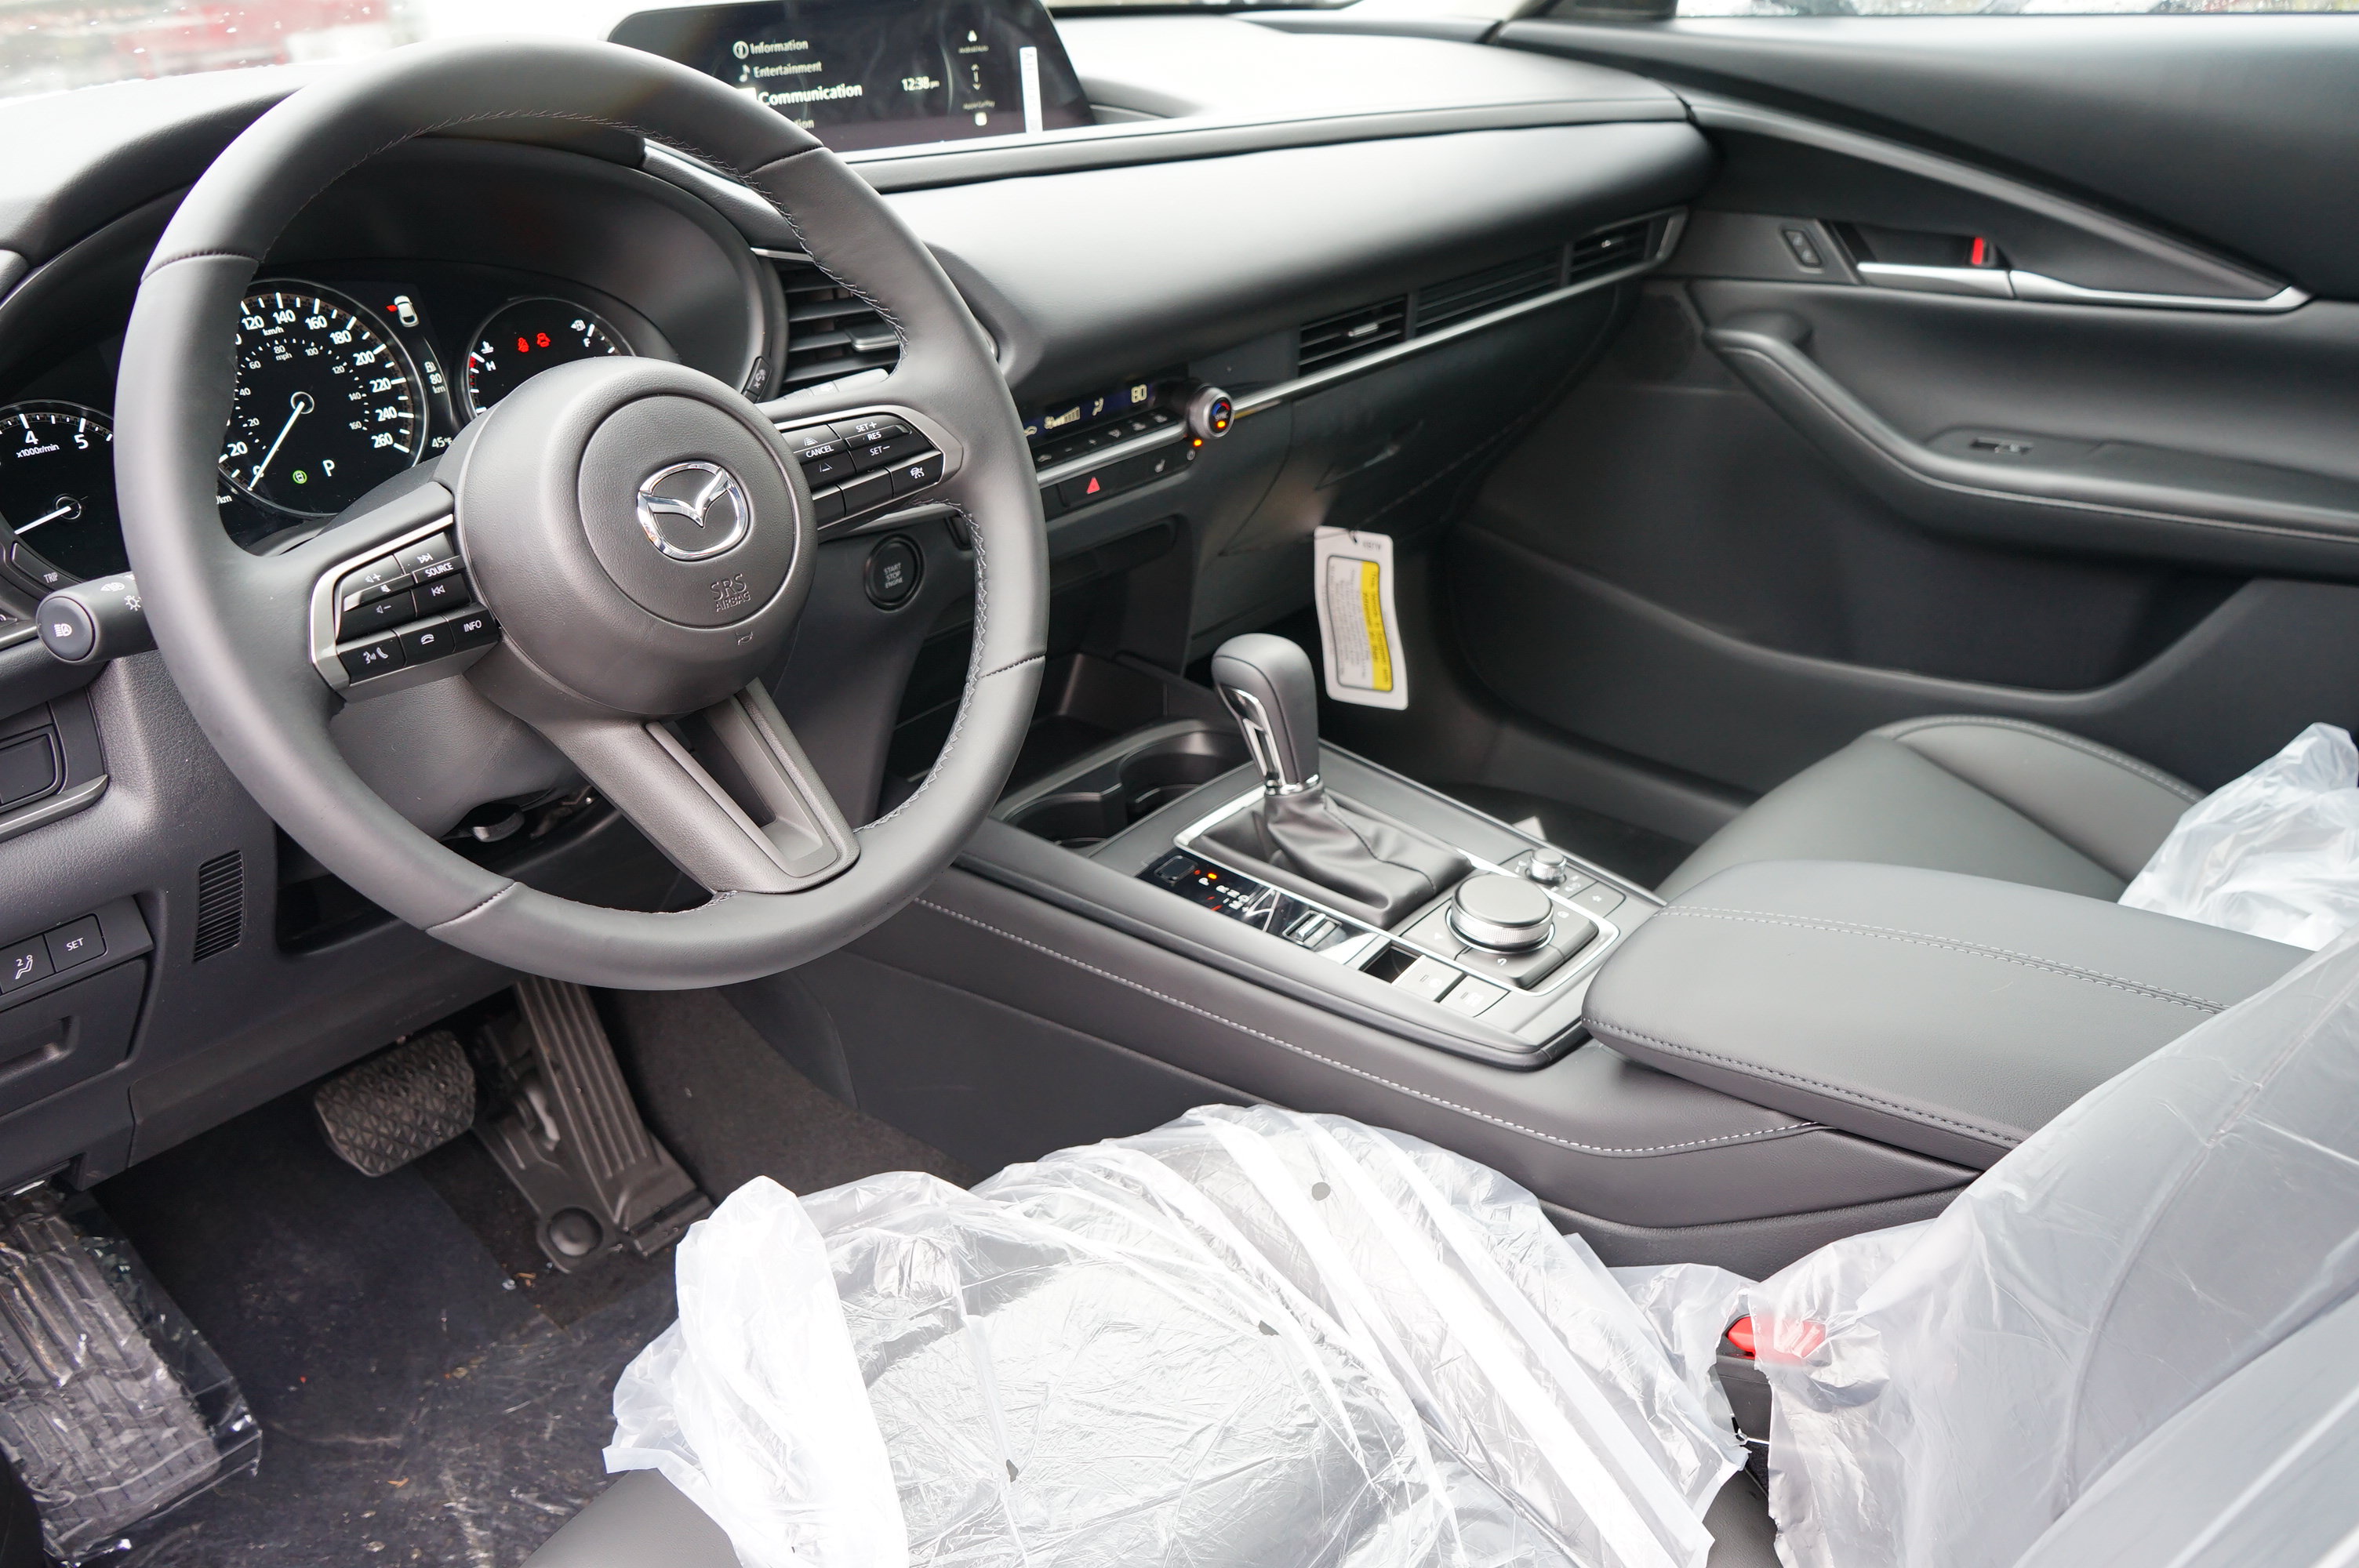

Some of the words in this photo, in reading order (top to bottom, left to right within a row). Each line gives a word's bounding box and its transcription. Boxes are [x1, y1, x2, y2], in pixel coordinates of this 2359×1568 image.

[750, 39, 809, 54] Information
[753, 61, 823, 78] Entertainment
[758, 83, 863, 106] Communication
[242, 314, 264, 330] 120
[273, 309, 296, 325] 140
[305, 314, 328, 330] 160
[262, 326, 285, 336] km/h
[329, 329, 352, 345] 180
[273, 345, 286, 354] 80
[275, 352, 293, 361] mph
[305, 347, 319, 357] 100
[249, 360, 261, 370] 60
[353, 350, 375, 366] 200
[332, 365, 345, 374] 120
[485, 361, 496, 371] H
[239, 387, 251, 396] 40
[369, 377, 391, 393] 220
[348, 392, 362, 401] 140
[375, 406, 398, 422] 240
[248, 418, 260, 427] 20
[349, 421, 362, 430] 160
[25, 430, 39, 445] 4
[74, 434, 89, 449] 5
[371, 433, 394, 448] 260
[867, 431, 881, 441] RES
[227, 441, 248, 457] 20
[805, 445, 834, 458] CANCEL
[322, 459, 335, 477] P
[425, 562, 454, 578] SOURCE
[884, 562, 902, 575] START
[44, 572, 58, 583] TRIP
[710, 572, 747, 601] SRS
[715, 591, 751, 612] AIRBAG
[463, 619, 482, 633] INFO
[66, 937, 84, 952] SET
